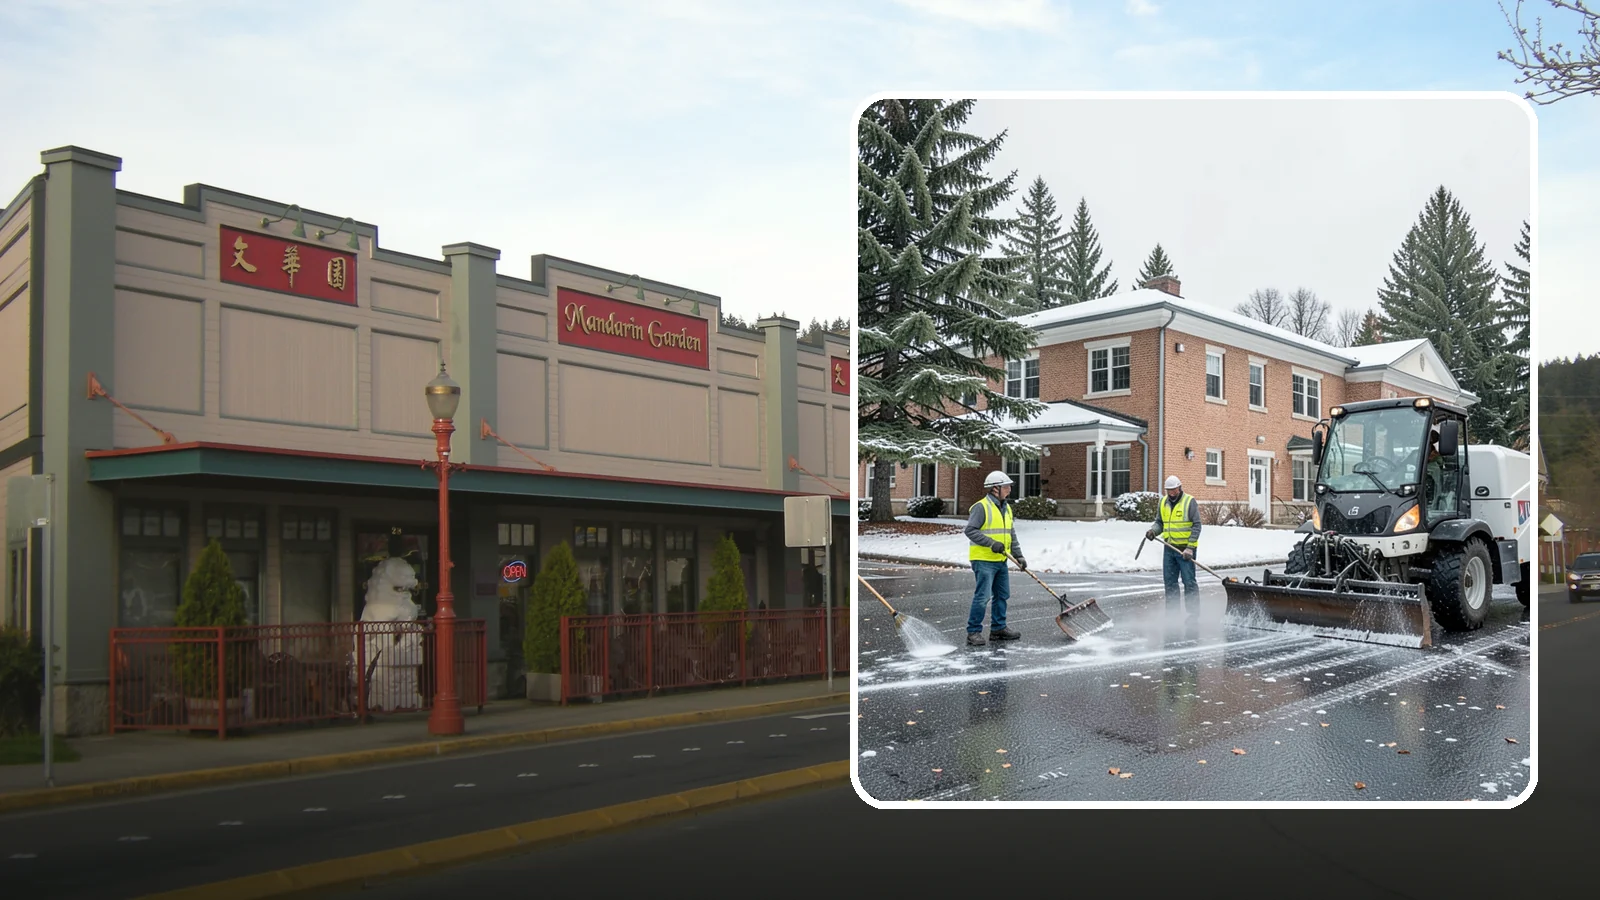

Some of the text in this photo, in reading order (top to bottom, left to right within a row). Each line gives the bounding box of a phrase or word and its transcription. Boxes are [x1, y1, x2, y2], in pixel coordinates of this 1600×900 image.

[230, 235, 346, 291] 文華園
[564, 302, 701, 352] Mandarin Garden
[503, 565, 527, 578] OPEN
